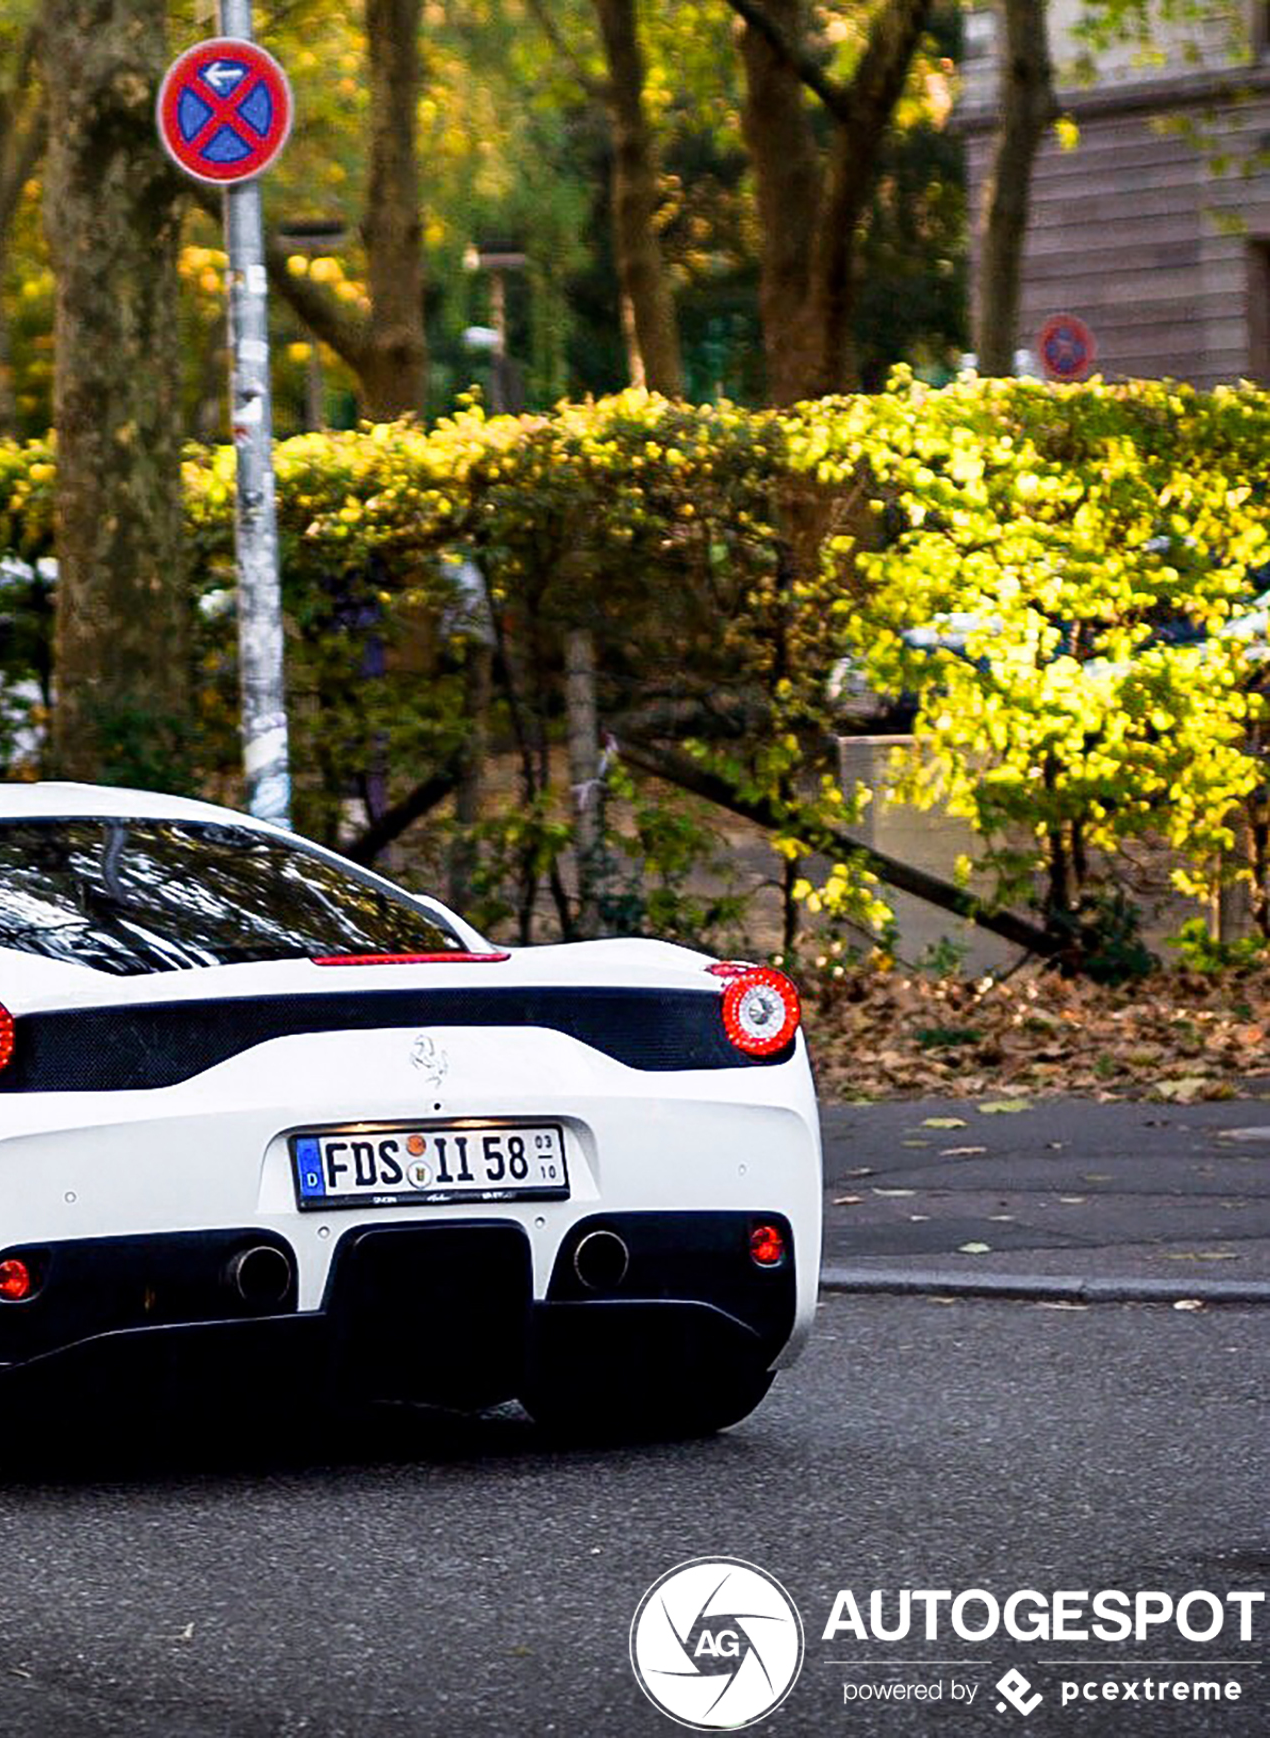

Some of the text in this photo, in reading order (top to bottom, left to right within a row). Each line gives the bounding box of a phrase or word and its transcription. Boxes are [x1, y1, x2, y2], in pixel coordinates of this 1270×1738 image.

[535, 1135, 553, 1149] 03
[325, 1136, 529, 1188] FDS II 58
[541, 1164, 556, 1179] 10
[306, 1172, 318, 1187] D
